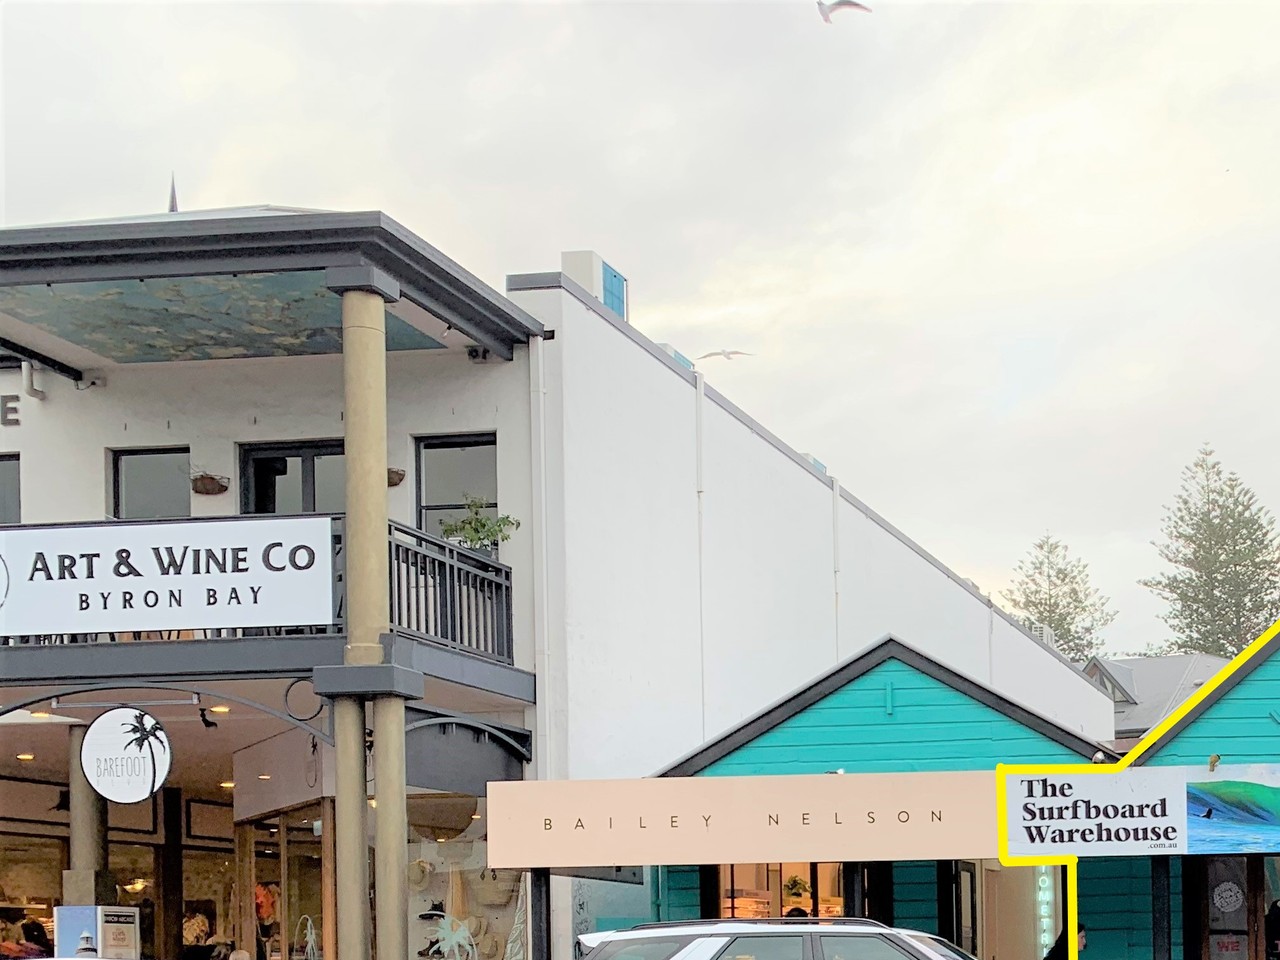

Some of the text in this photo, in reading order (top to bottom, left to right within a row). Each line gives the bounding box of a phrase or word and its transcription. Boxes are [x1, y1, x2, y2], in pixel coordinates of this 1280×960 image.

[28, 551, 100, 582] ART
[112, 548, 144, 577] &
[152, 545, 250, 576] WINE
[78, 585, 263, 611] BYRON BAY
[96, 756, 147, 778] BAREFOOT
[1020, 778, 1074, 798] The
[1022, 797, 1168, 822] Surfboard
[543, 810, 943, 831] BAILEY NELSON
[1022, 822, 1178, 843] Warehouse
[1147, 841, 1178, 849] .com.au
